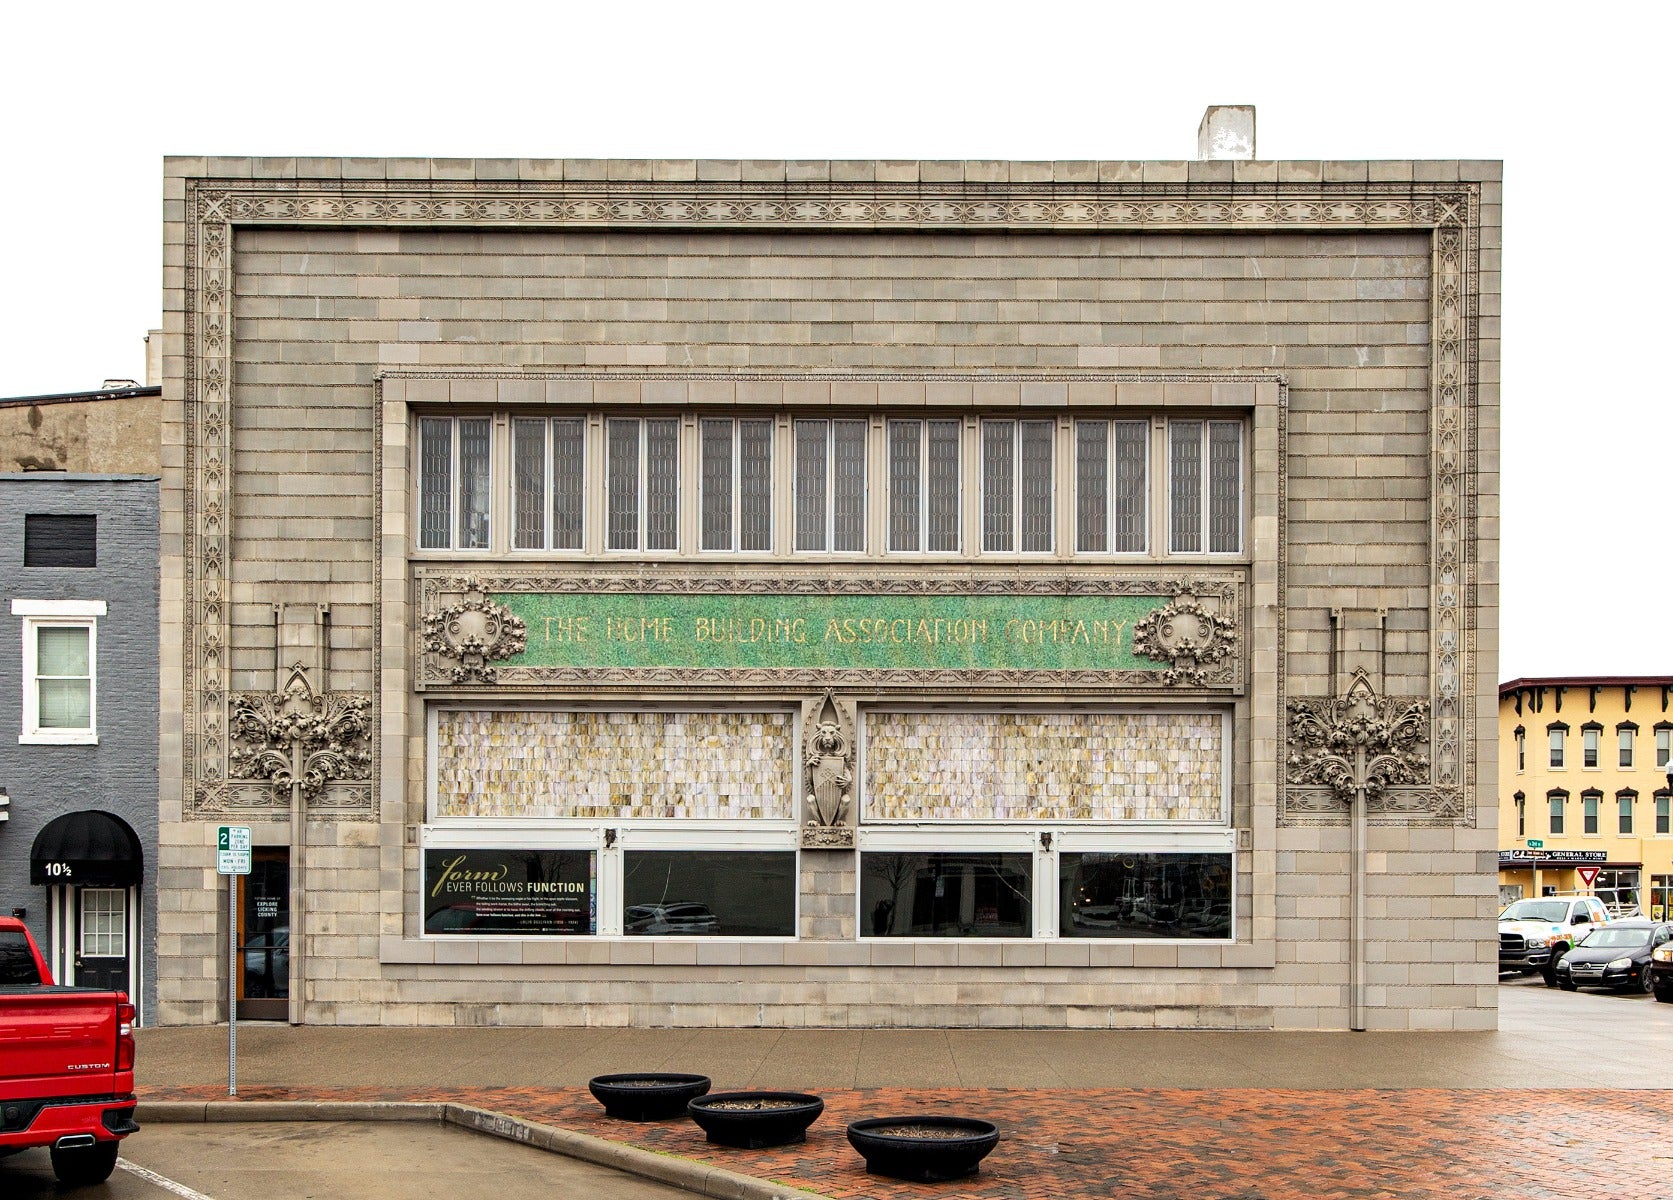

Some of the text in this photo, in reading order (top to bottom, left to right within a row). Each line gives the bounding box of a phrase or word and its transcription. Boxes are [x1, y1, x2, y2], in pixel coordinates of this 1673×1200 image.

[542, 617, 1127, 645] THE HOME BUILDING ASSOCIATION COMPANY
[220, 833, 228, 845] 2
[45, 862, 72, 877] 10½
[431, 854, 508, 898] form
[447, 882, 585, 893] EVER FOLLOWS FUNCTION
